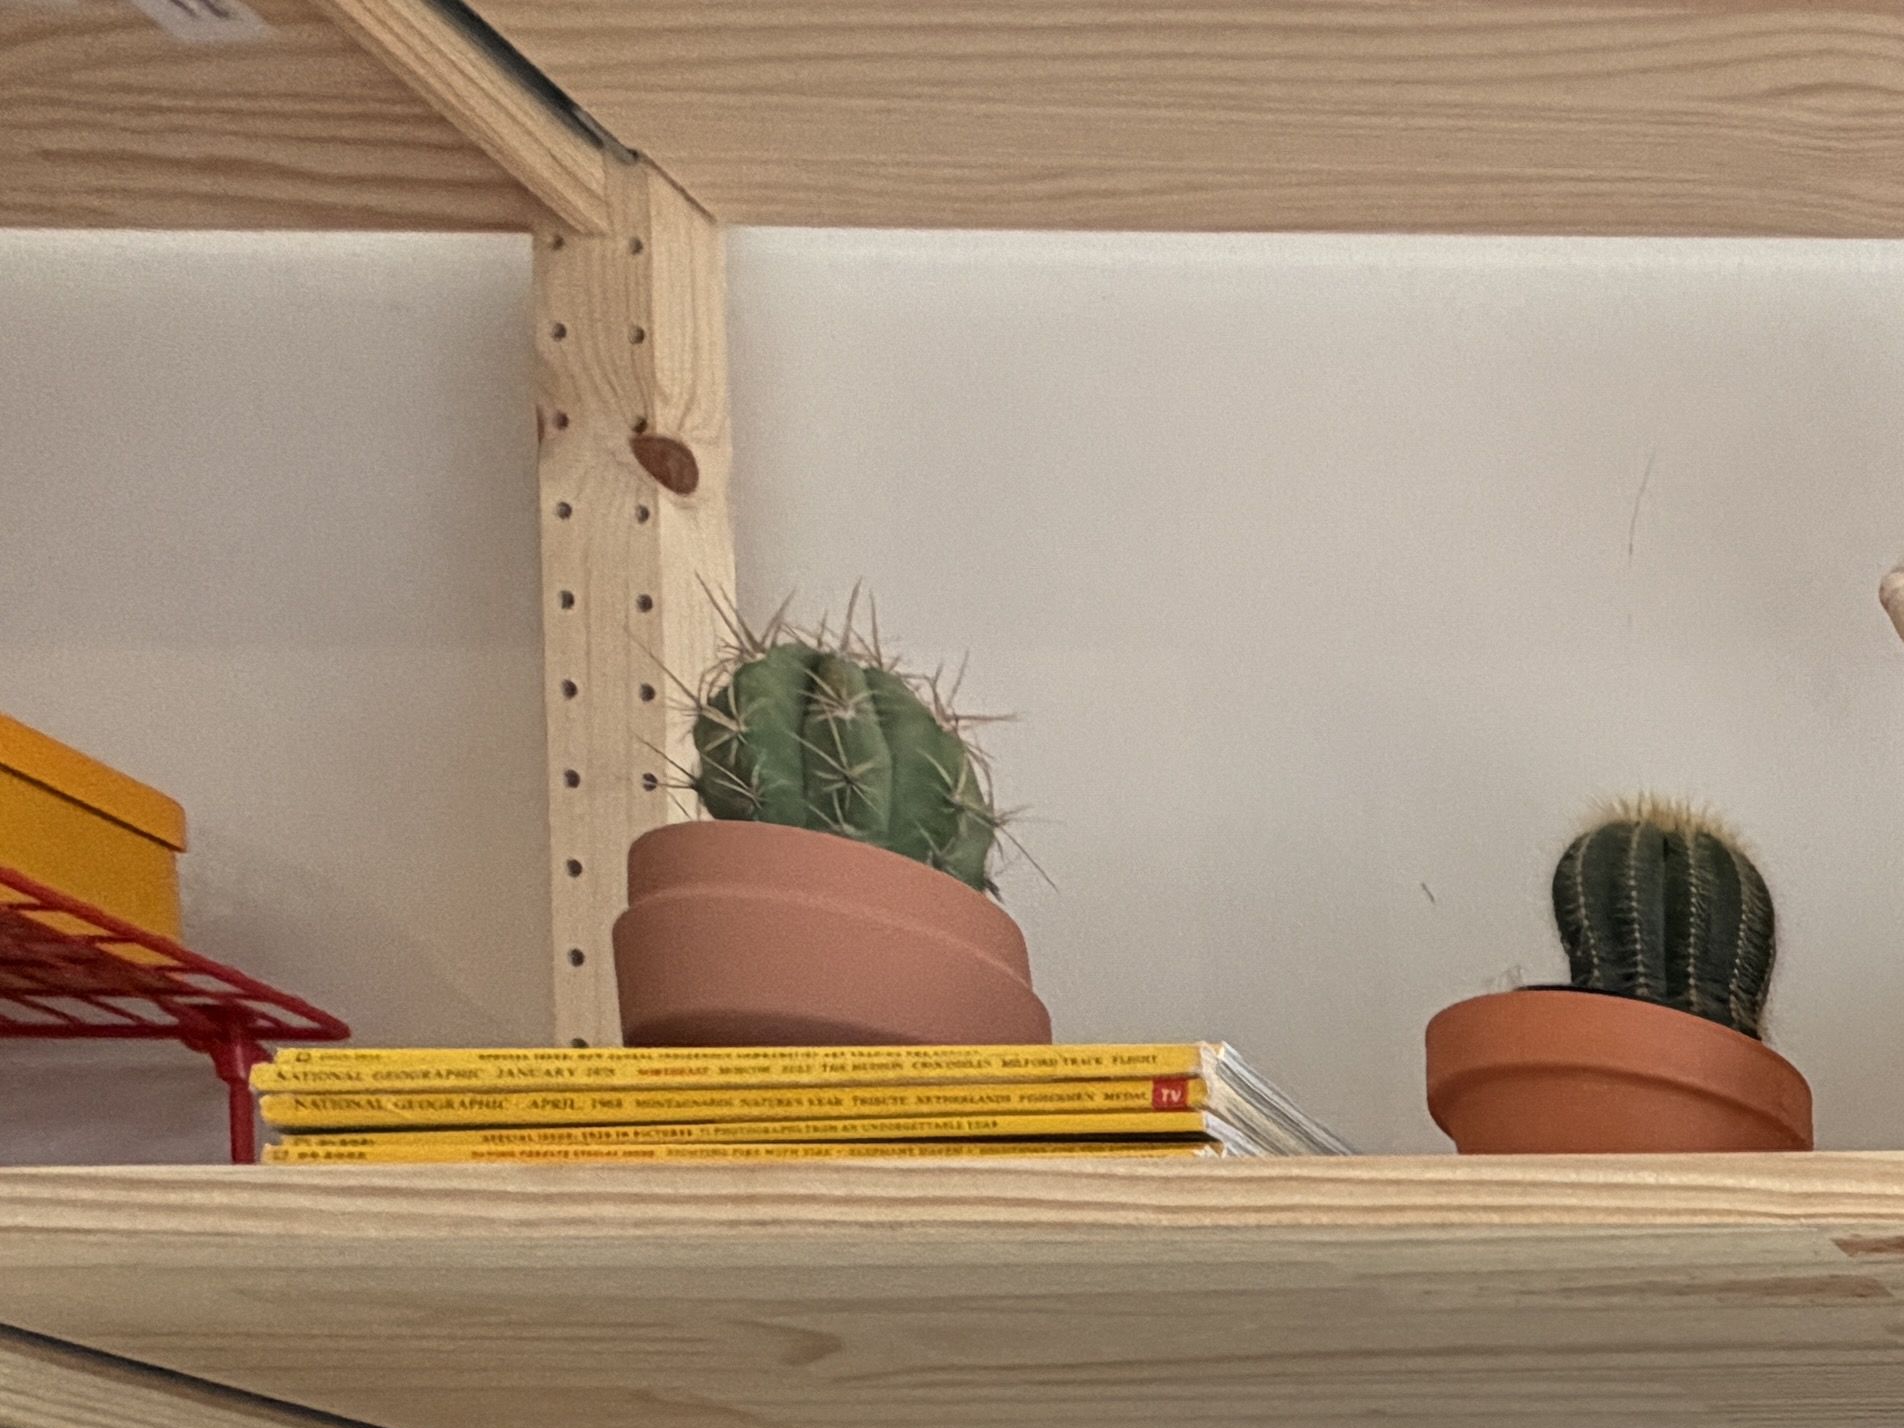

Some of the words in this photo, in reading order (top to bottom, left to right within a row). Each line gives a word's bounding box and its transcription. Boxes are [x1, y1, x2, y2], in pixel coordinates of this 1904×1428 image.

[276, 1070, 362, 1082] NATIONAL
[371, 1068, 479, 1081] GEOGRAPHIC
[1160, 1088, 1183, 1104] TV
[293, 1097, 384, 1111] NATIONAL
[392, 1097, 507, 1111] GEOGRAPHIC
[530, 1098, 582, 1111] APRIL
